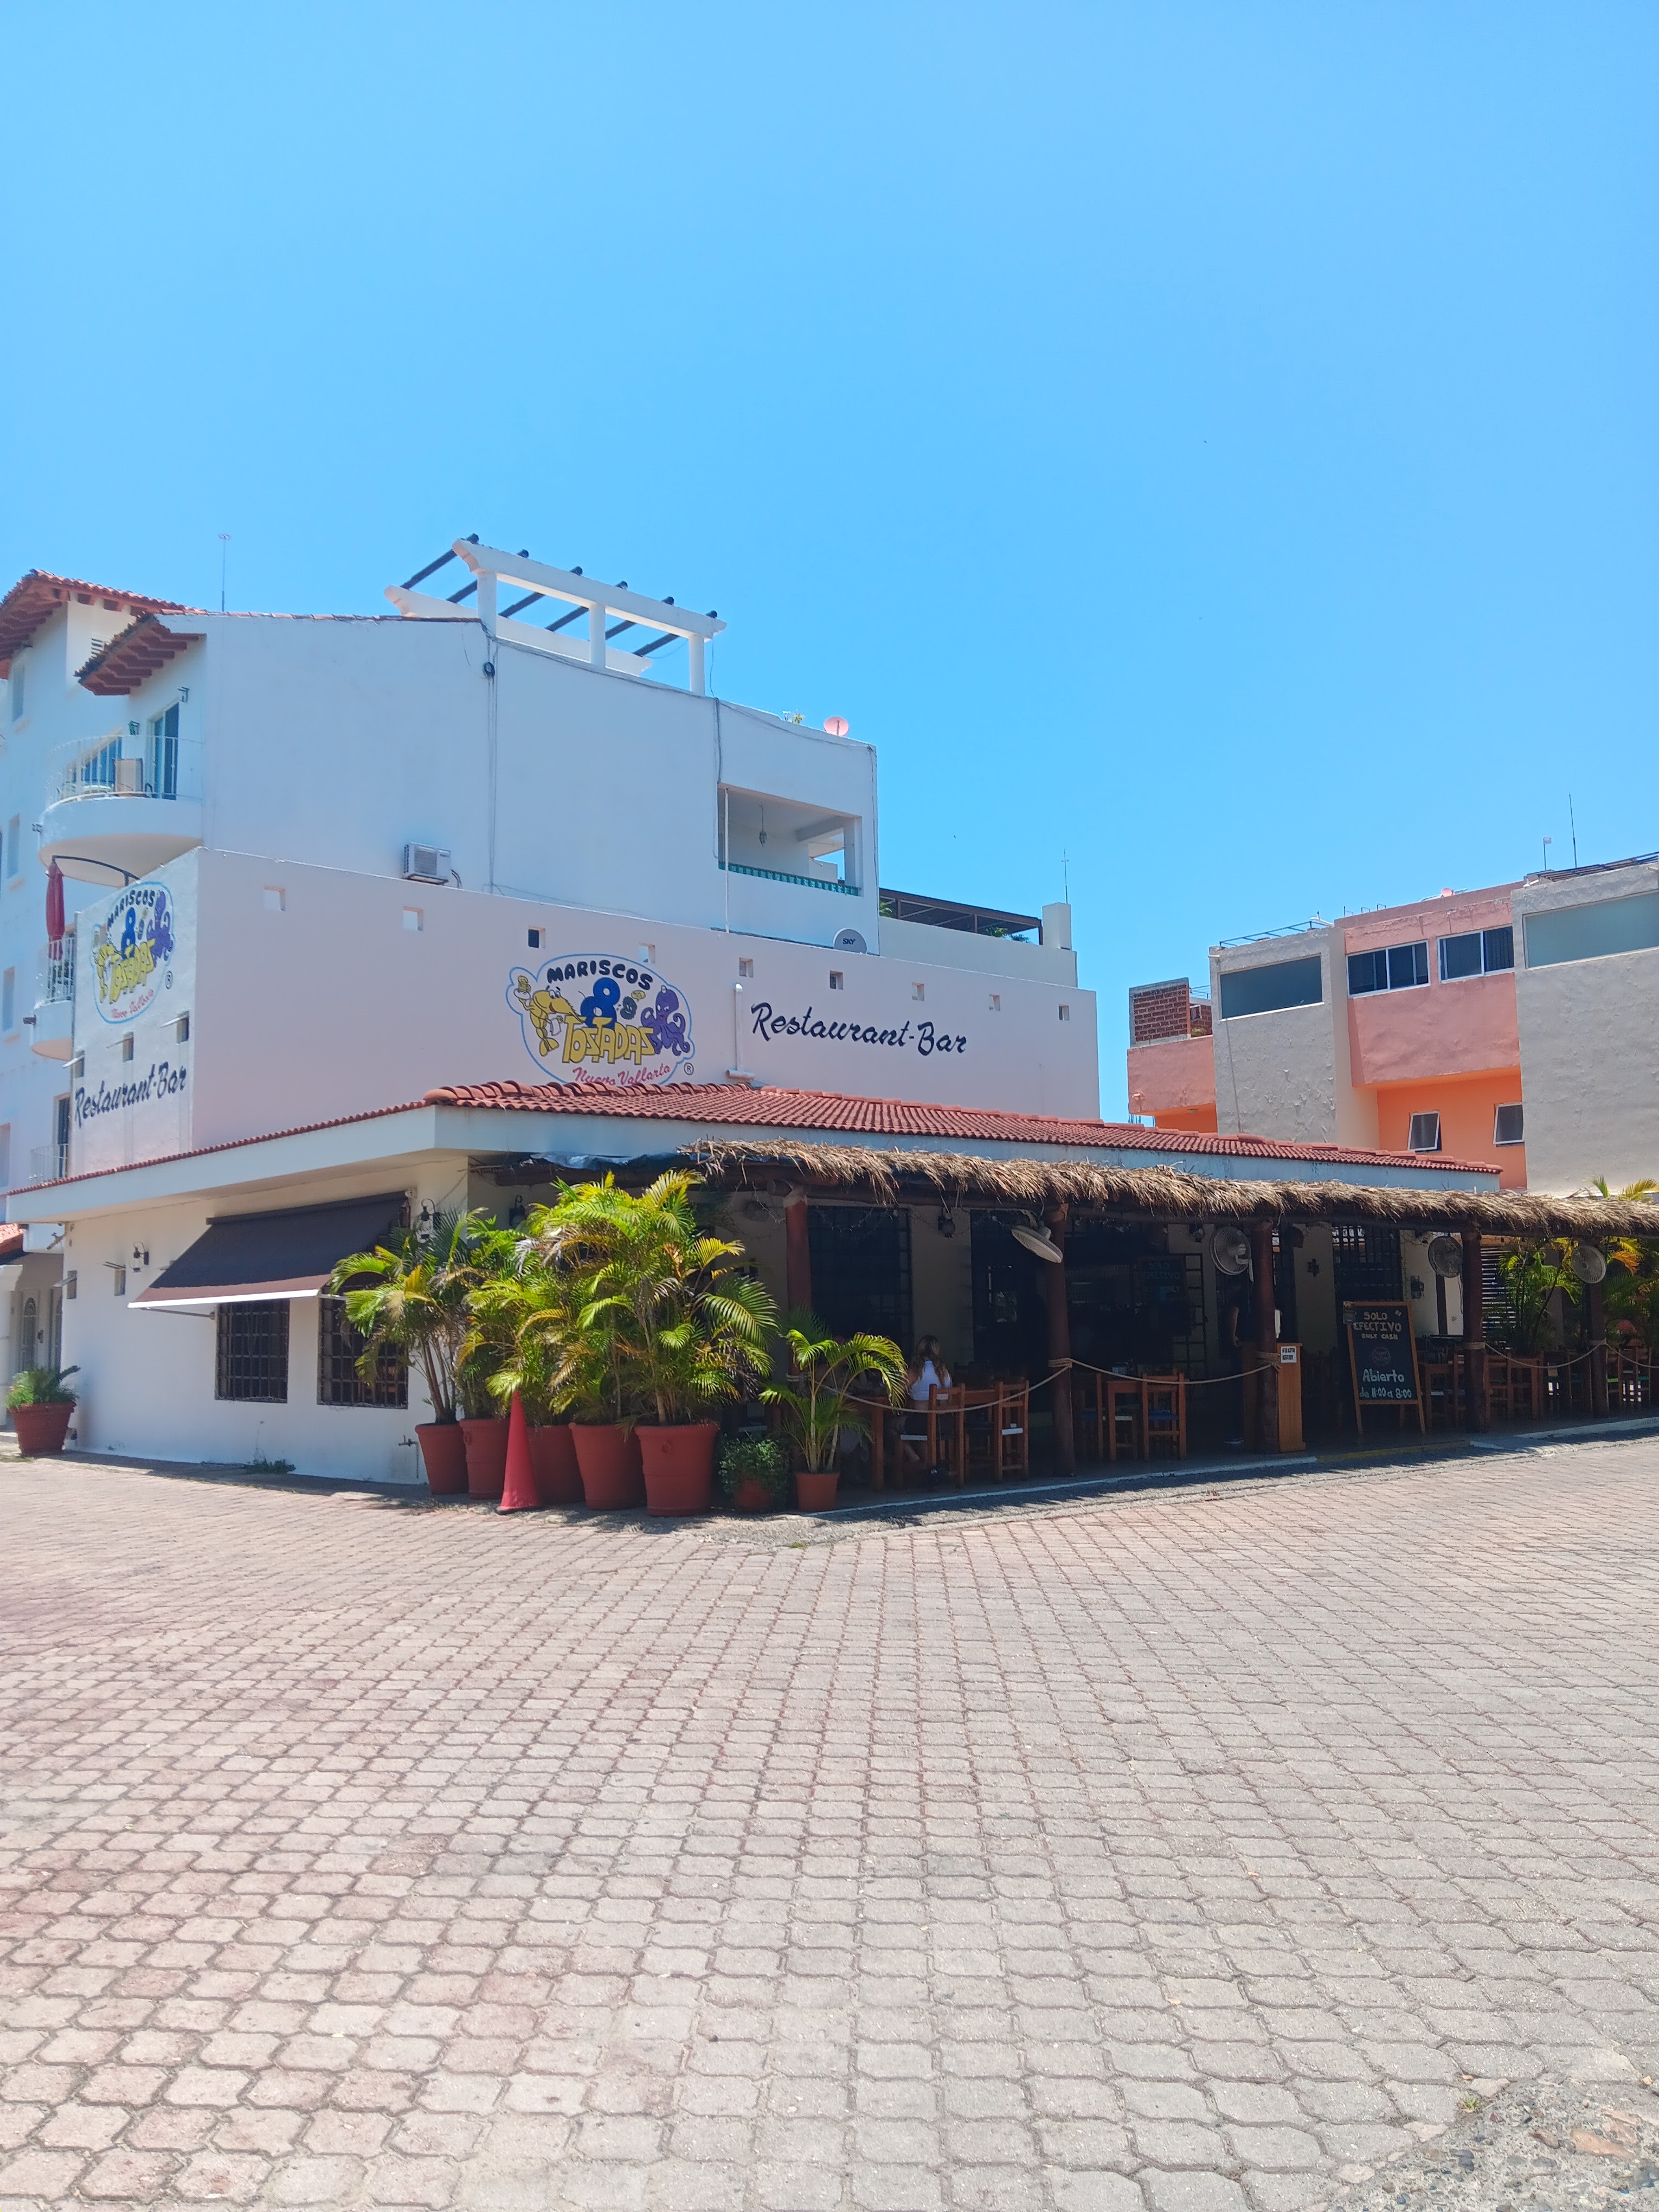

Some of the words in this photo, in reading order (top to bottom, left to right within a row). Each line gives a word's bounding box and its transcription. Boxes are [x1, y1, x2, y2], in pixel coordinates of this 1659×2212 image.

[107, 889, 155, 928] MARISCOS
[121, 907, 136, 961] 8
[546, 960, 653, 991] MARISCOS
[580, 976, 621, 1030] 8
[562, 1015, 657, 1065] TOSTADAS
[750, 1002, 967, 1057] Restaurant-Bar
[572, 1066, 616, 1085] Nuevo
[617, 1062, 671, 1085] Vallarta
[74, 1060, 187, 1129] Restaurant-Bar
[1353, 1322, 1402, 1333] EFECTIVO
[1364, 1311, 1388, 1321] SOLO
[1362, 1368, 1405, 1383] Abierto
[1371, 1387, 1387, 1398] 11:00
[1395, 1387, 1412, 1399] 8:00
